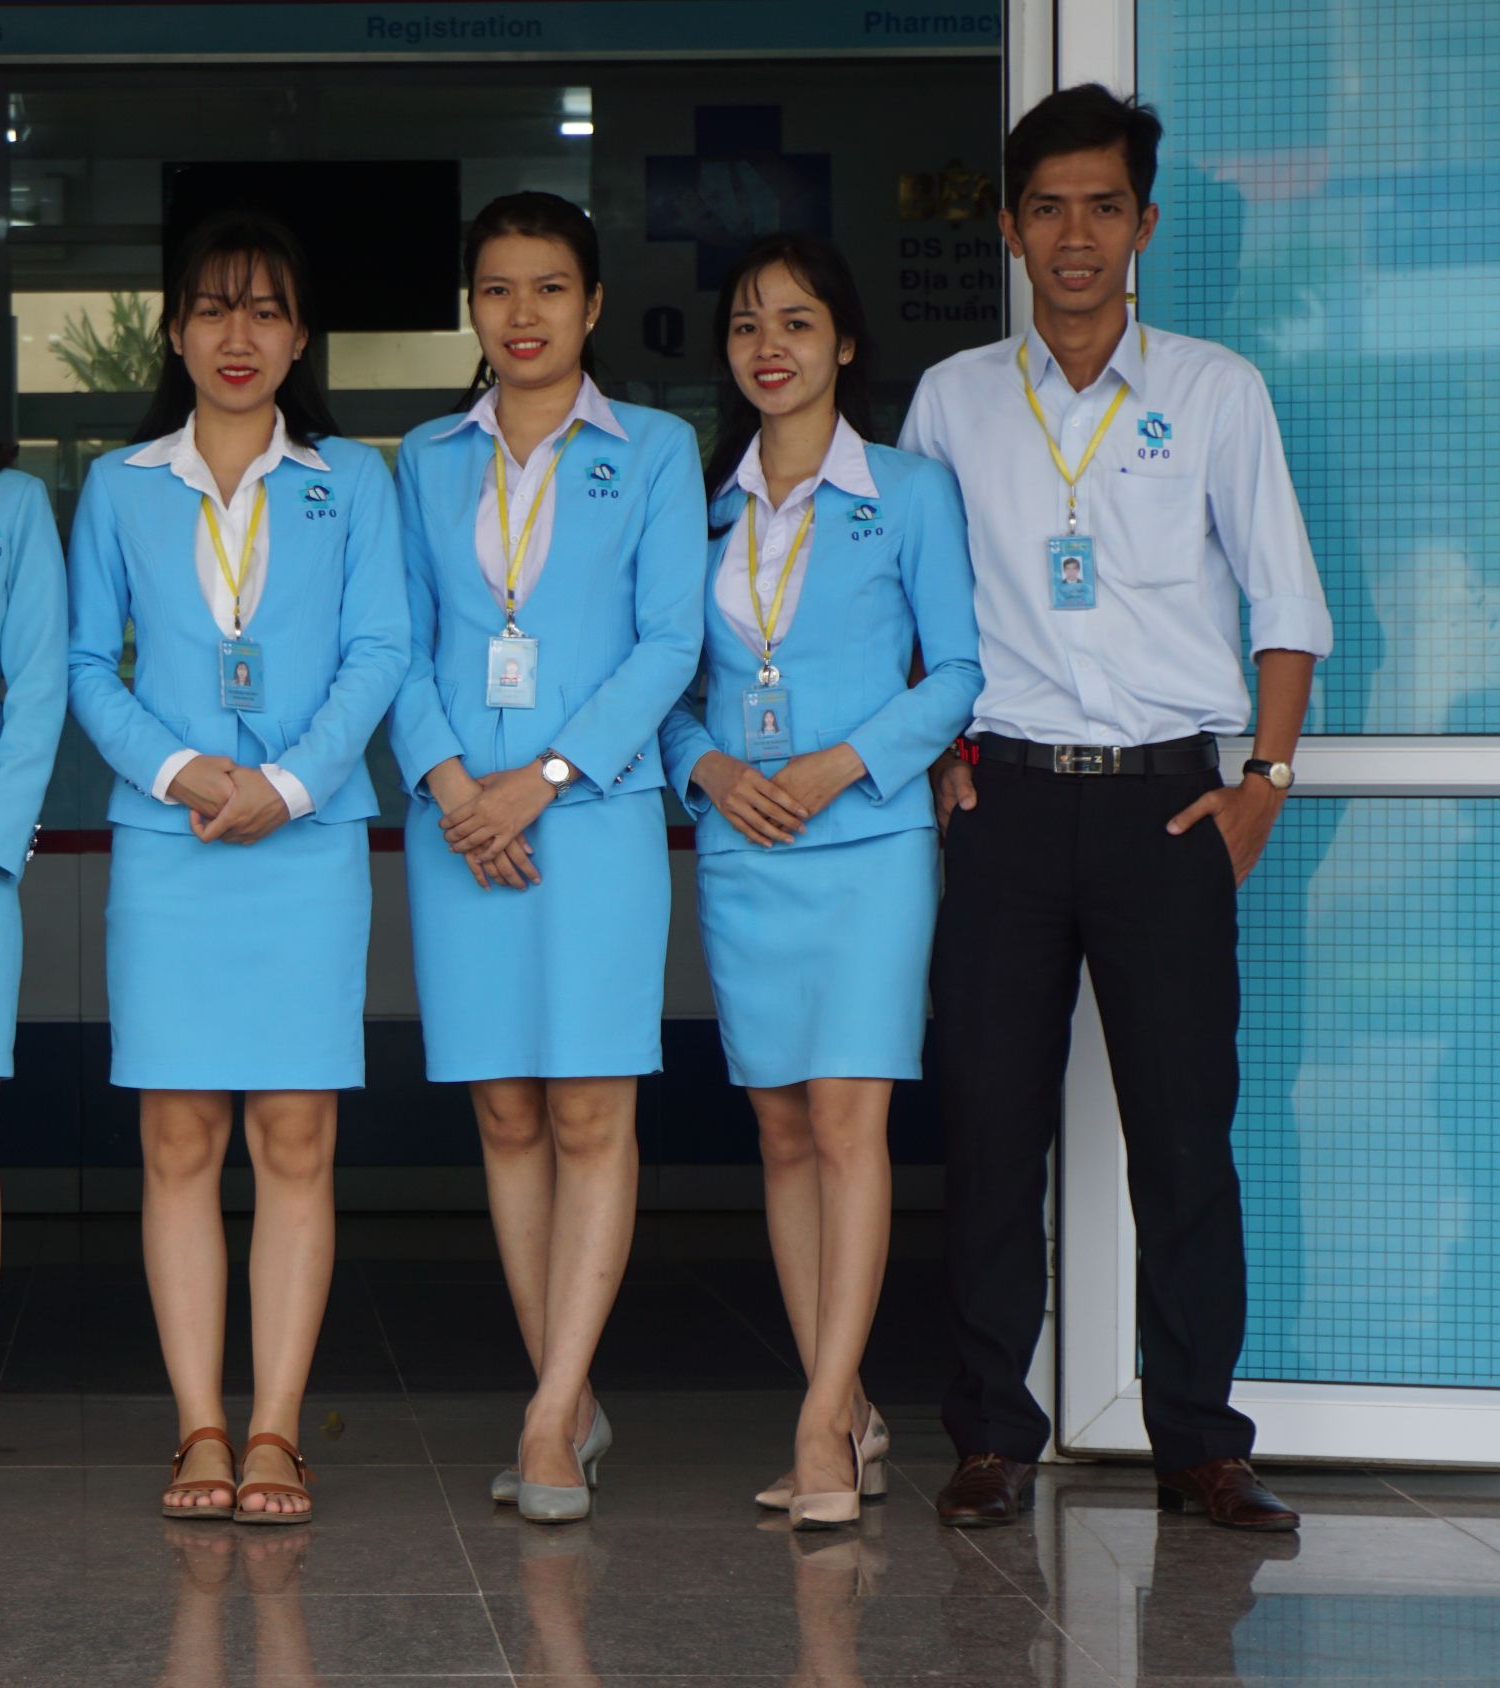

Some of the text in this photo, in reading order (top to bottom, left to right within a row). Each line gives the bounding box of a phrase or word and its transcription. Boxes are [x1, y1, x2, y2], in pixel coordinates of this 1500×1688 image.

[367, 15, 541, 44] Registration
[900, 238, 942, 258] DS
[900, 267, 949, 294] Địa
[1138, 448, 1170, 459] QPO
[588, 489, 619, 499] QPO
[306, 509, 337, 520] QPO
[851, 527, 883, 541] QPO
